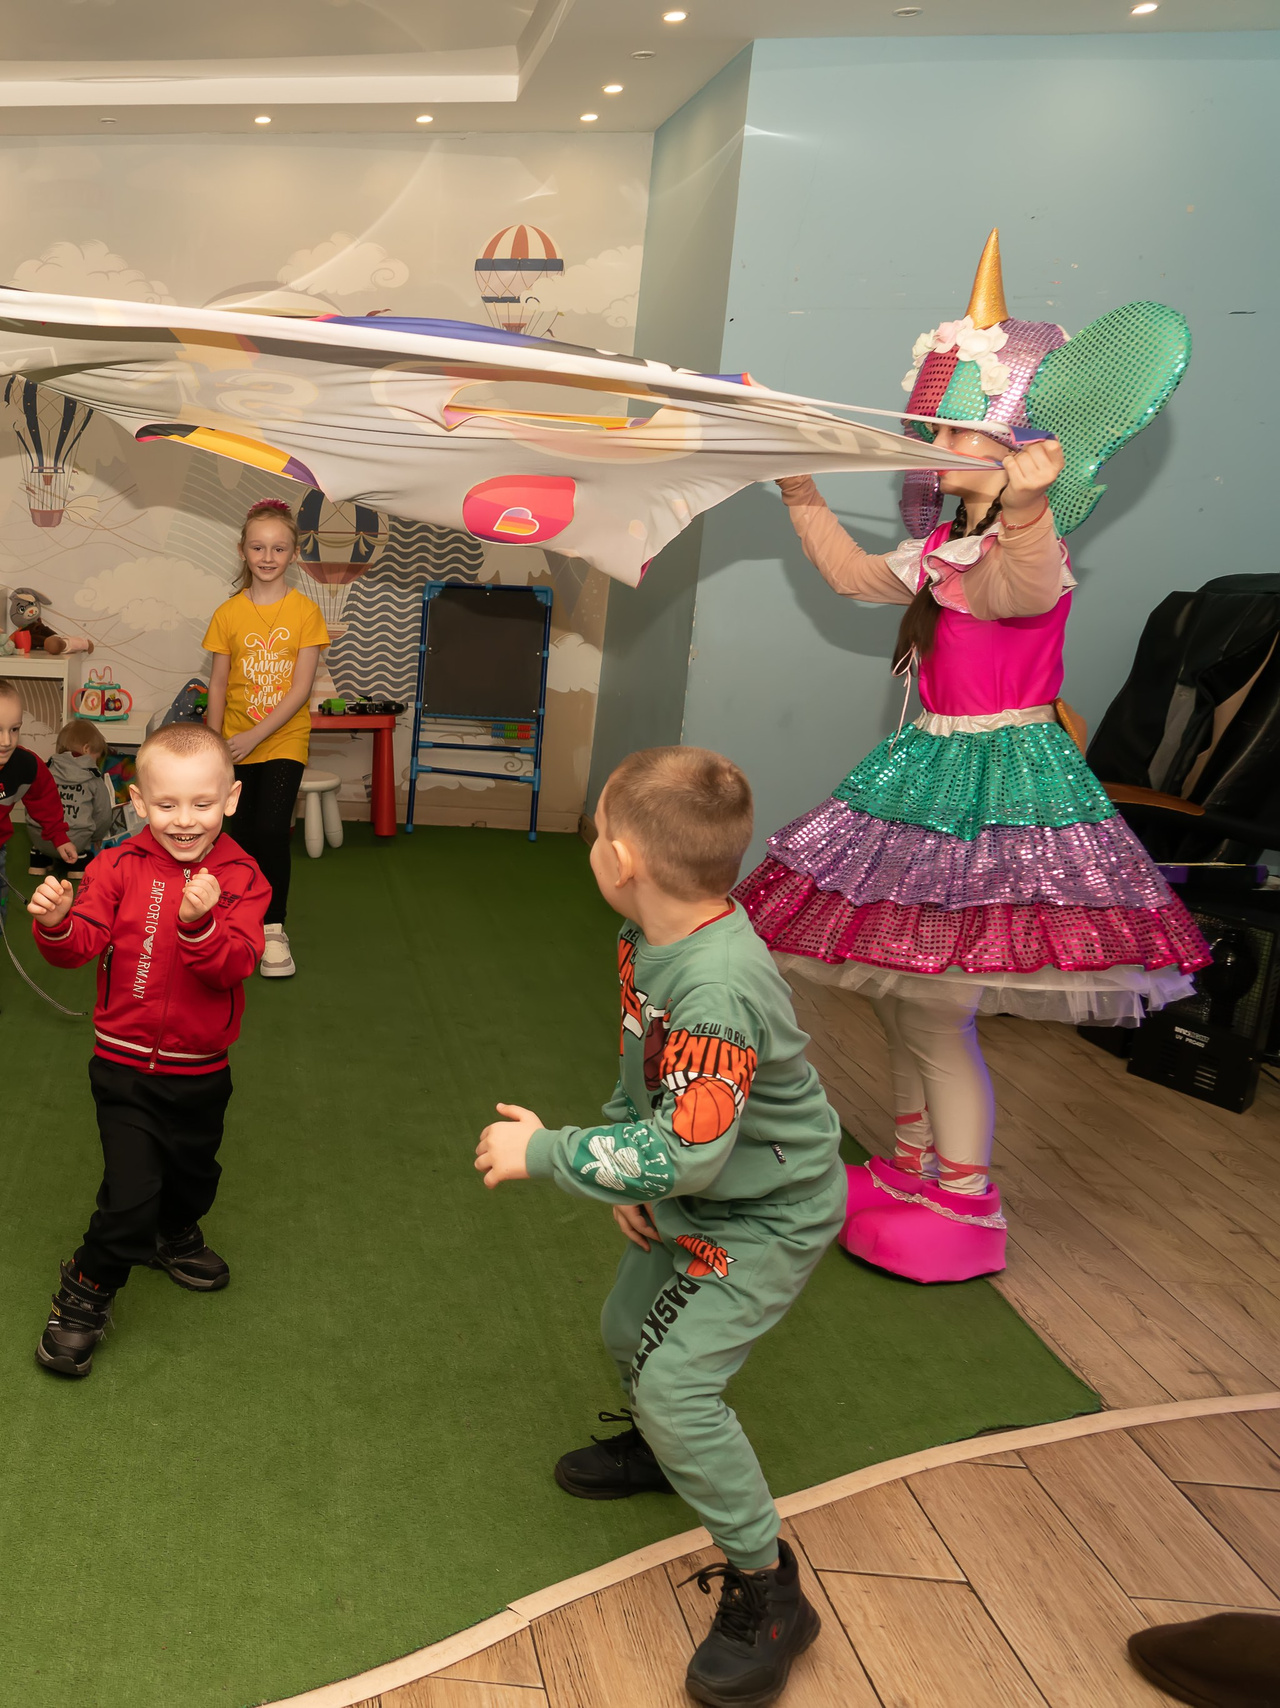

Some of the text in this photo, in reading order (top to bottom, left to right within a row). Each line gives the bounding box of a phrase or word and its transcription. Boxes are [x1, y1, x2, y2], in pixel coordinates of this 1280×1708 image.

[257, 649, 279, 660] This
[240, 656, 293, 680] Bunny
[253, 673, 283, 685] HOPS
[262, 685, 274, 693] on
[250, 690, 284, 707] wine
[133, 879, 165, 999] EMPORIO ARMANI
[692, 1022, 721, 1036] NEW
